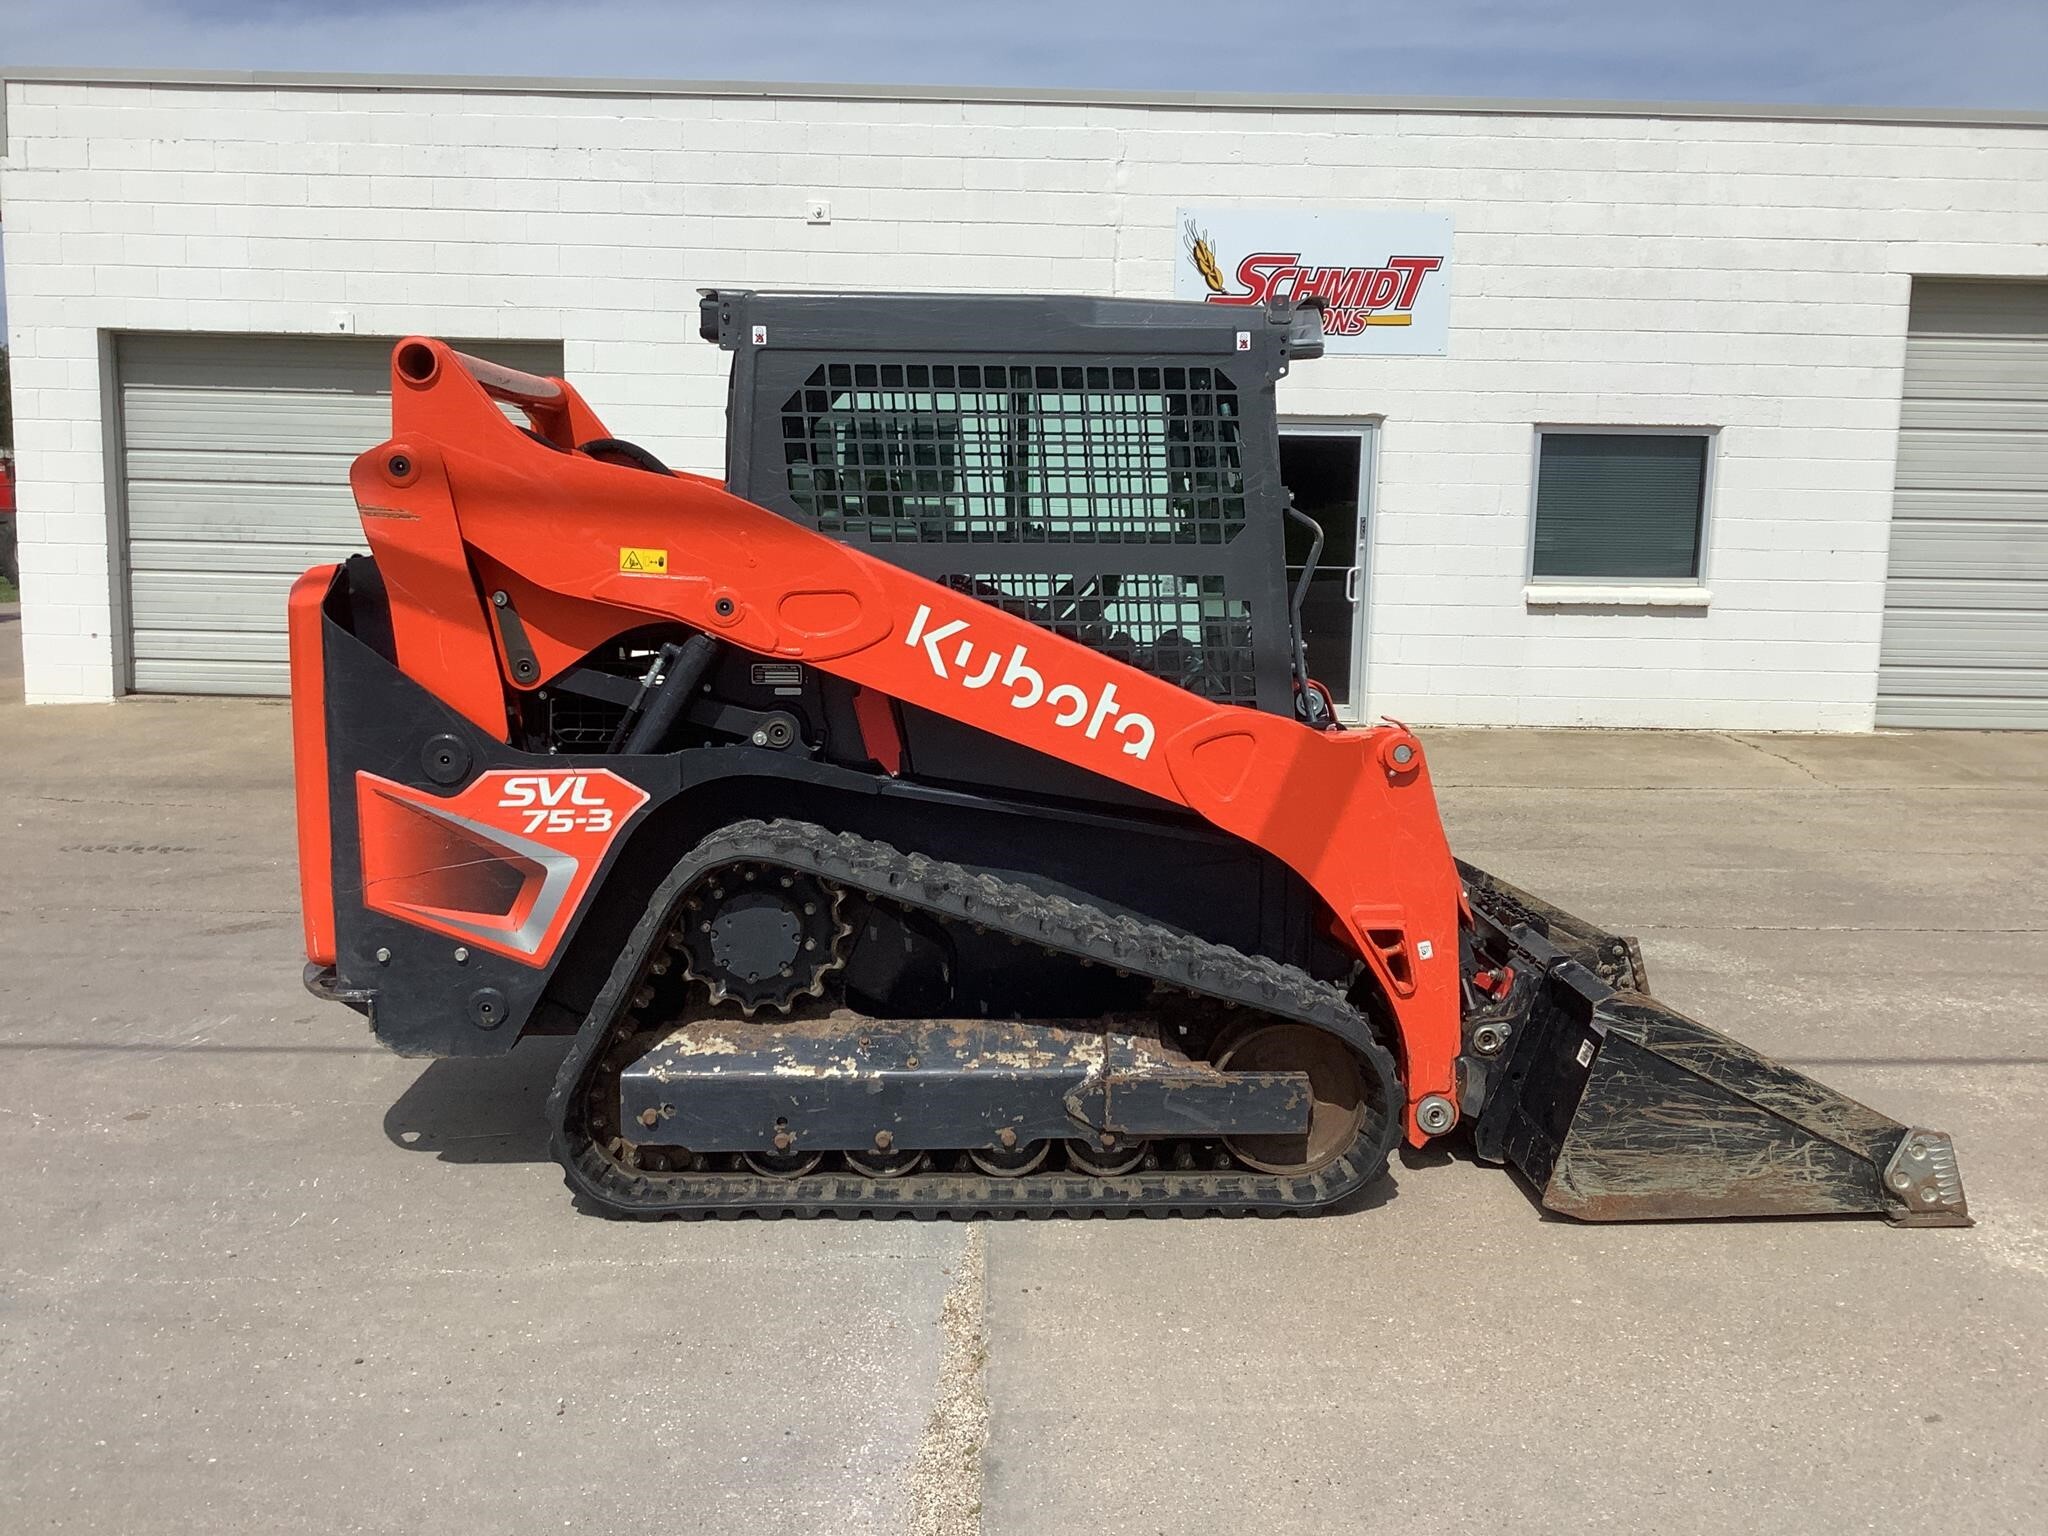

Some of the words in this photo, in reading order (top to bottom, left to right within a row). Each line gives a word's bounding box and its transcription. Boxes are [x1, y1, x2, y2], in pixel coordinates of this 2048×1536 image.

[1206, 252, 1444, 311] SCHMIDT
[905, 604, 1155, 760] Kubota
[498, 776, 605, 807] SVL
[522, 809, 613, 833] 75-3
